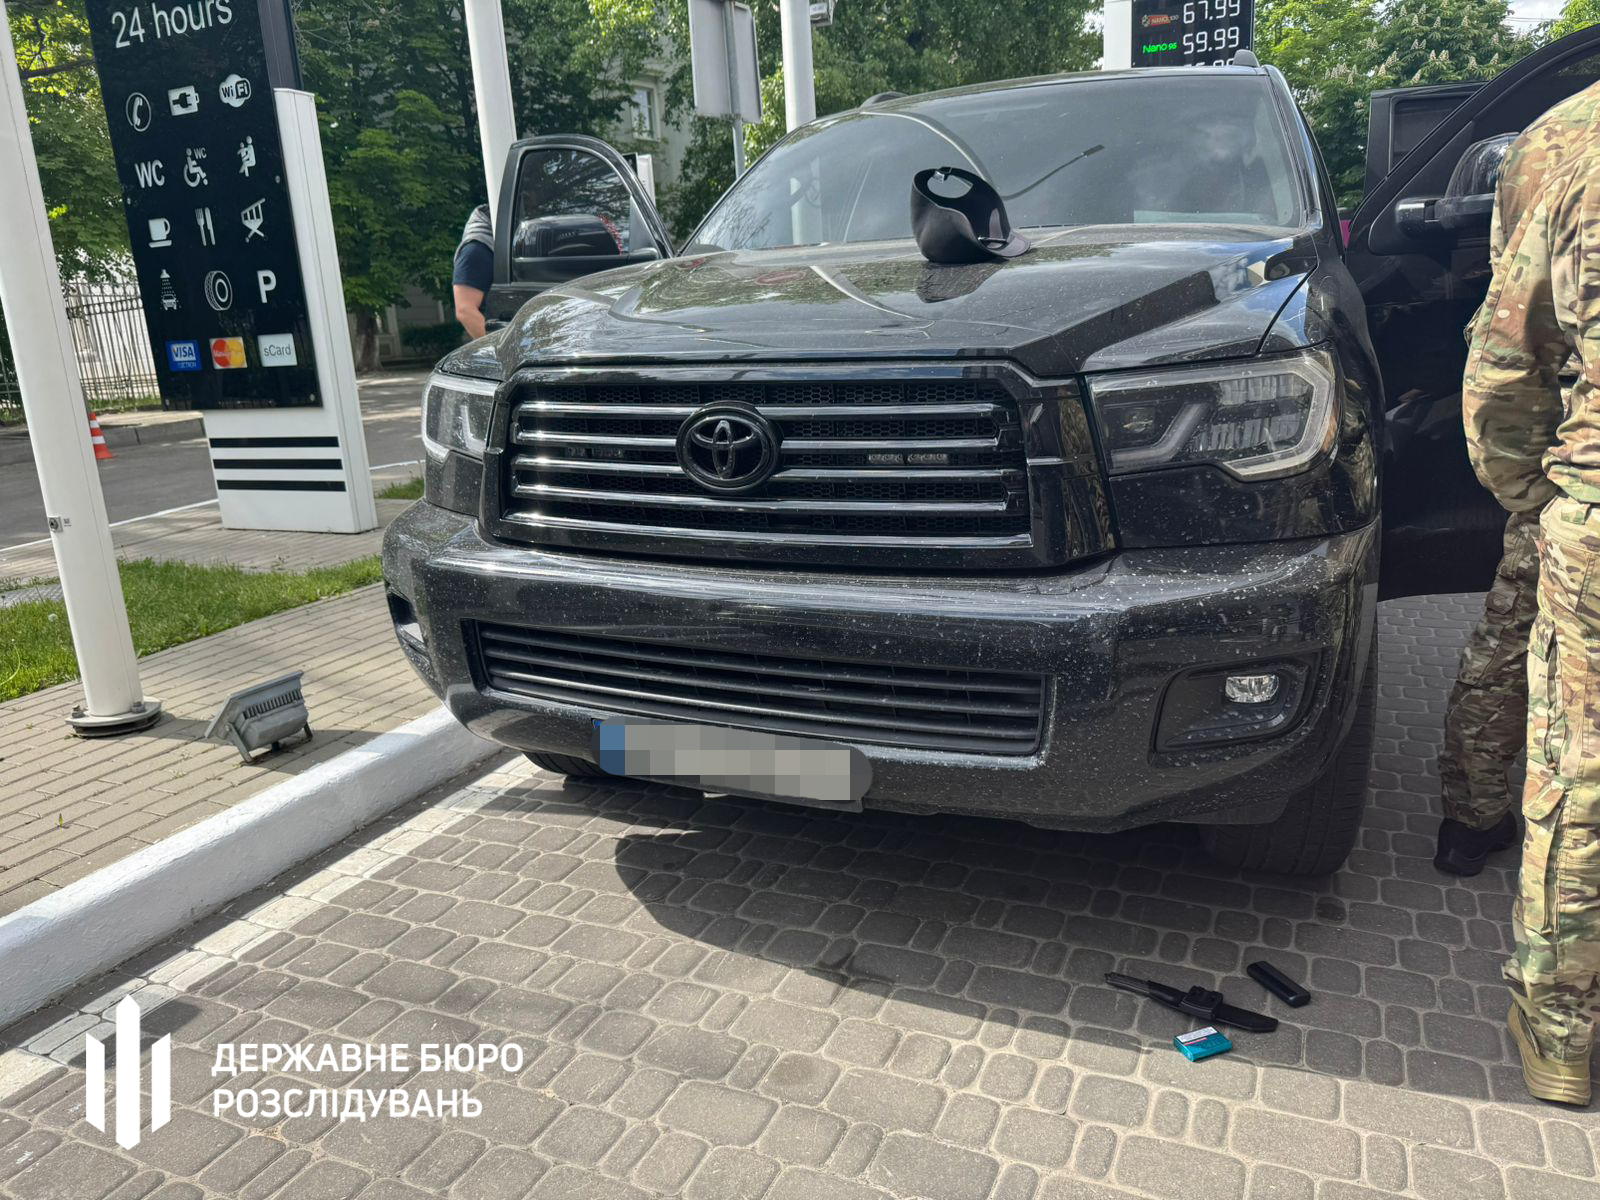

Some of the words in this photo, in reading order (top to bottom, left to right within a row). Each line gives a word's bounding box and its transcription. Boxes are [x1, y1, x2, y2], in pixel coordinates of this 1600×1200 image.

[112, 6, 146, 48] 24
[151, 0, 232, 39] hours
[1183, 0, 1240, 24] 67.99
[1182, 26, 1240, 54] 59.99
[193, 147, 207, 159] WC
[134, 159, 165, 188] WC
[256, 269, 277, 303] P
[173, 346, 195, 358] VISA
[263, 344, 292, 356] sCard
